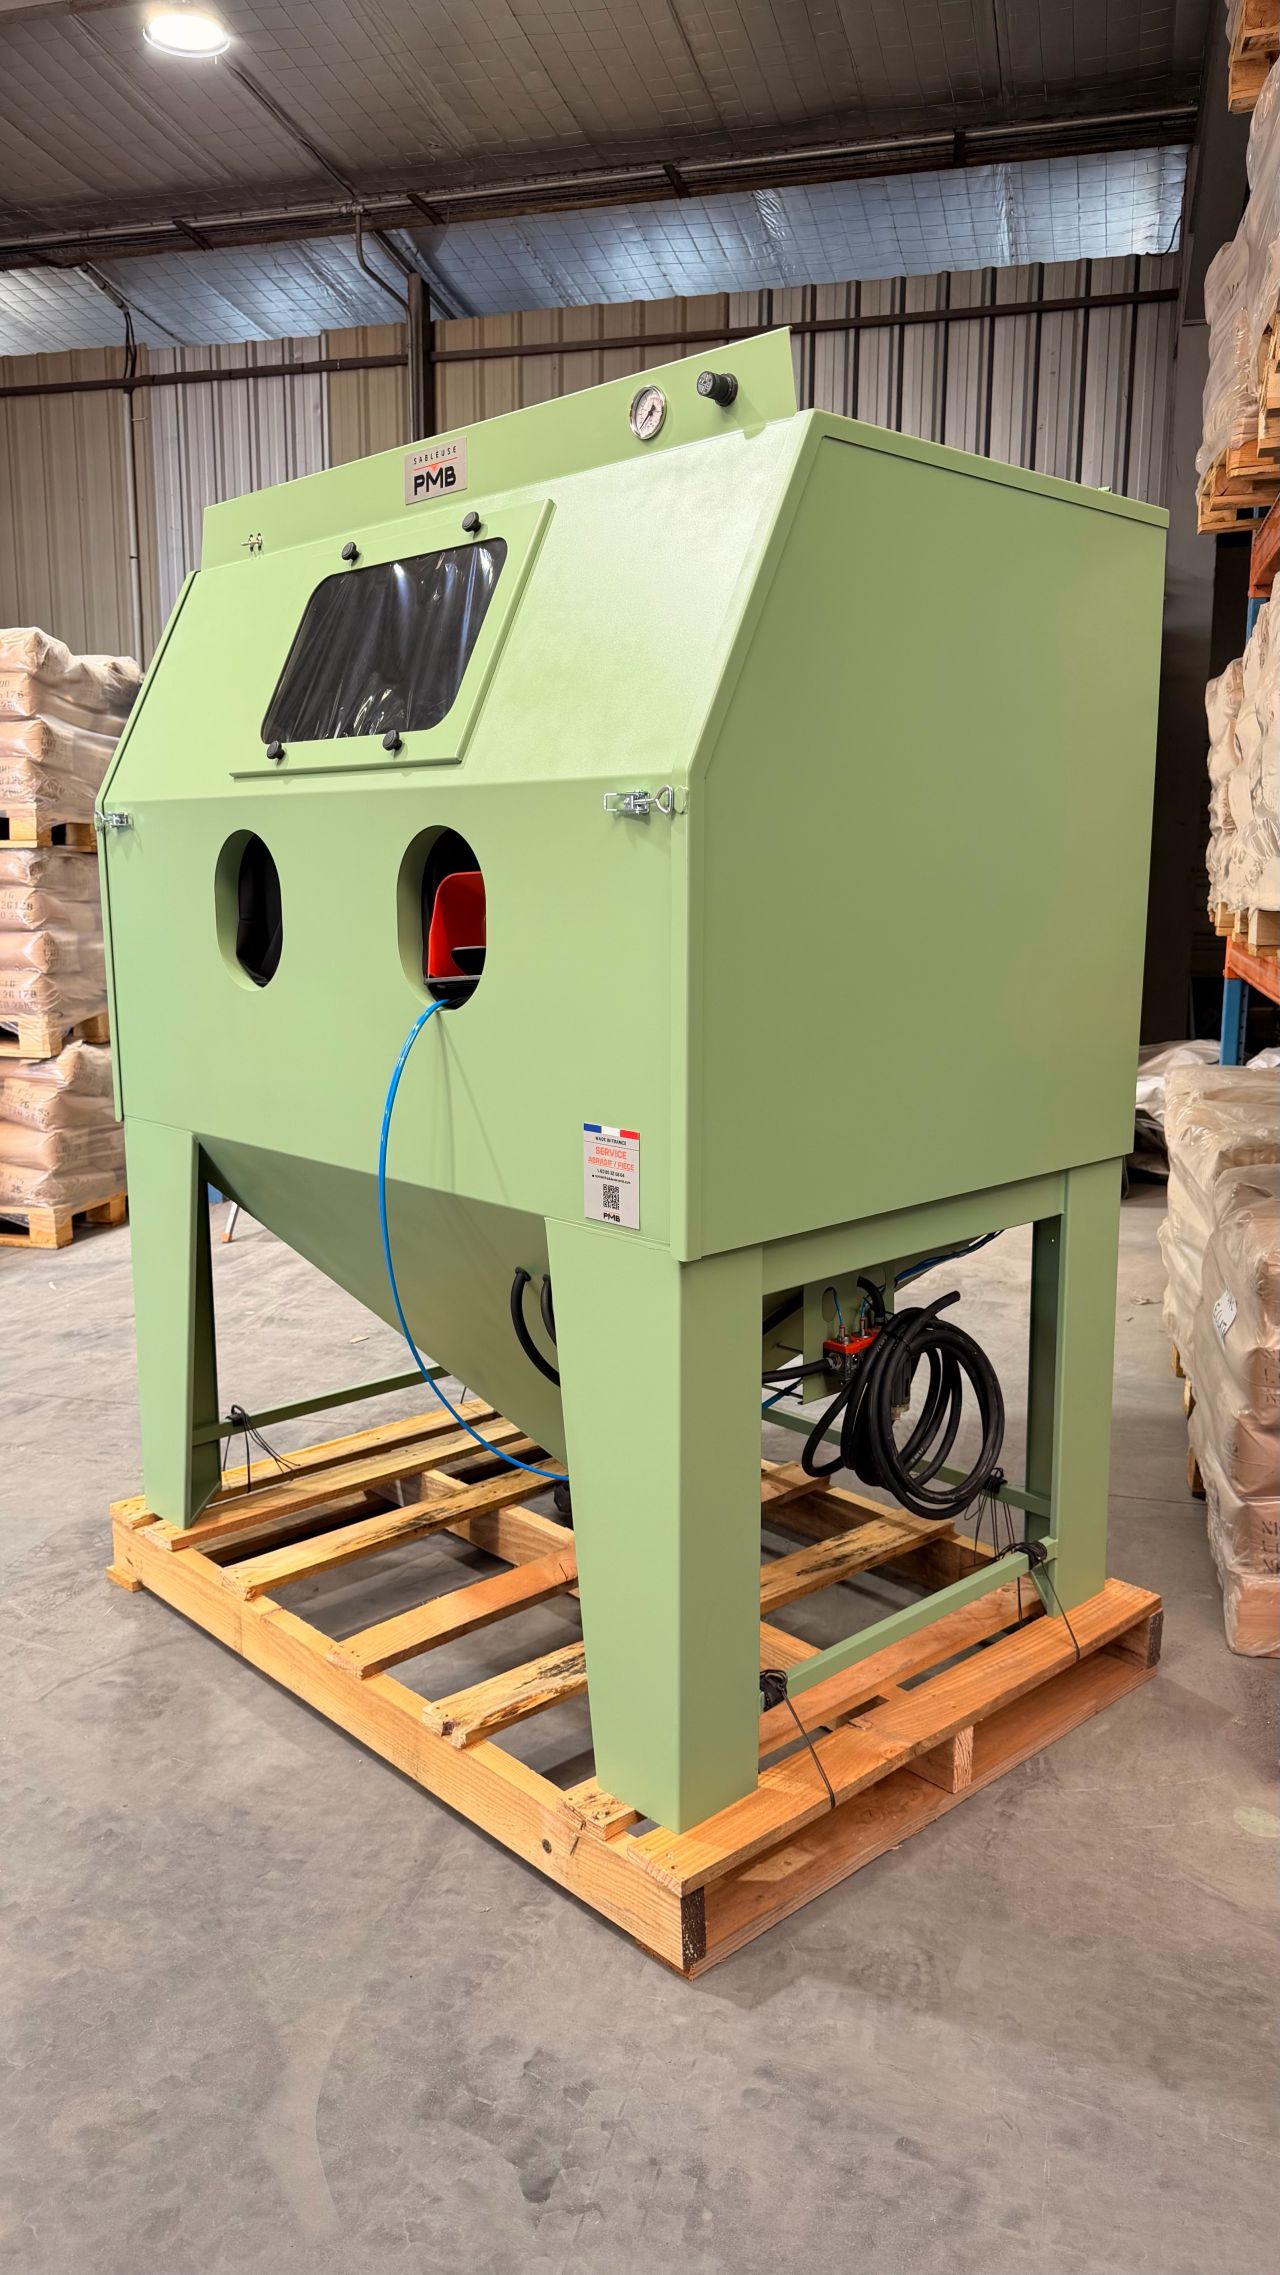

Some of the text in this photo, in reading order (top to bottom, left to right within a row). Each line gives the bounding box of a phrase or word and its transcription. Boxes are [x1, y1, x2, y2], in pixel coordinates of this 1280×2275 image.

[413, 445, 457, 465] SABLEUSE
[413, 465, 457, 496] PMB
[595, 1146, 627, 1160] SERVICE
[603, 1212, 621, 1223] PMB
